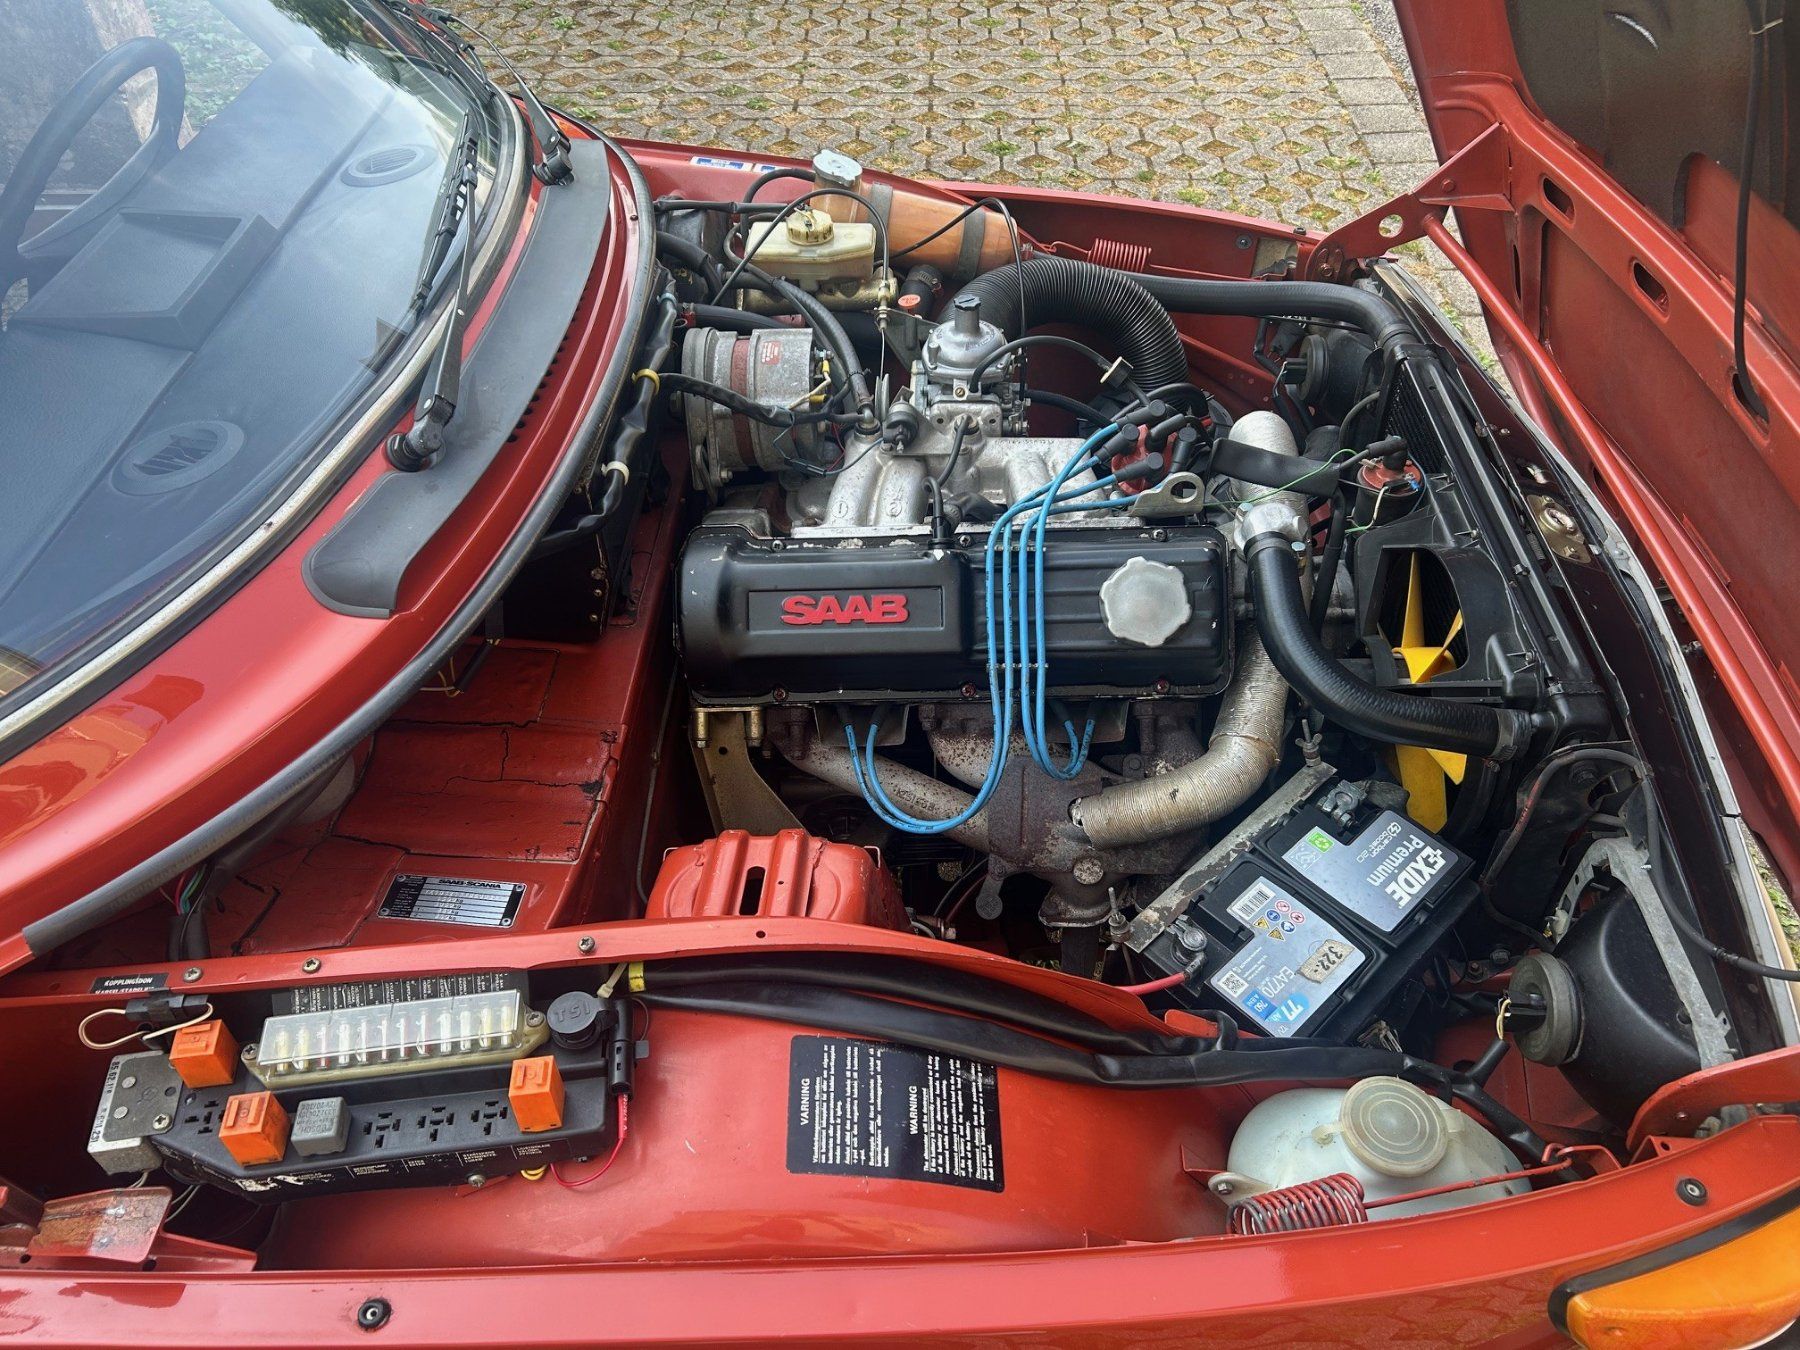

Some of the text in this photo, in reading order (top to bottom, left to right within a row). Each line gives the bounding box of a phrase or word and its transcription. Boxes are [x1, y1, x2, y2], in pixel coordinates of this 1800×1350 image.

[781, 594, 909, 625] SAAB
[1367, 835, 1425, 886] Premium
[1371, 835, 1392, 858] carbon
[1385, 846, 1446, 908] EXIDE
[1262, 966, 1294, 998] EA770
[553, 1000, 590, 1022] TSI
[1281, 1000, 1304, 1021] 77
[800, 1078, 810, 1126] VARNING
[909, 1085, 918, 1135] WARNING
